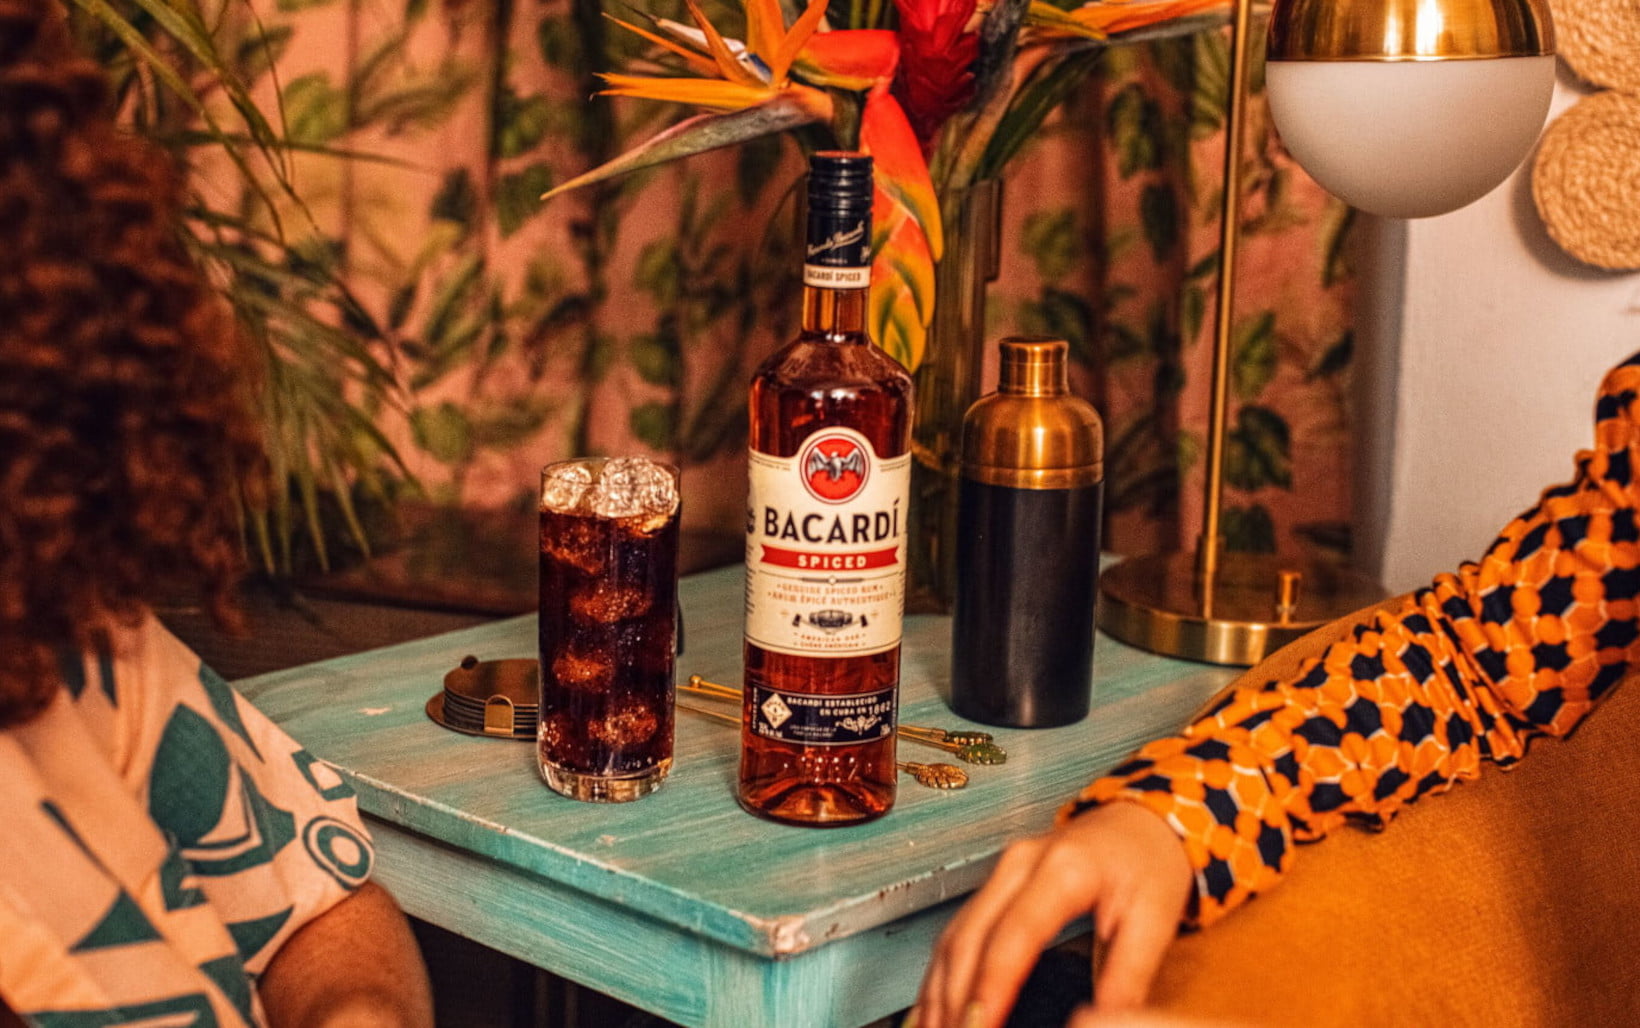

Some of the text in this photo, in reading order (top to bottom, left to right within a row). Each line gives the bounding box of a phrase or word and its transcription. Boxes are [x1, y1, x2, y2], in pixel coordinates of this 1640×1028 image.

[765, 498, 900, 543] BACARDÍ
[798, 555, 867, 569] SPICED
[825, 697, 877, 707] ESTABLECIDO
[833, 708, 855, 716] CUBA
